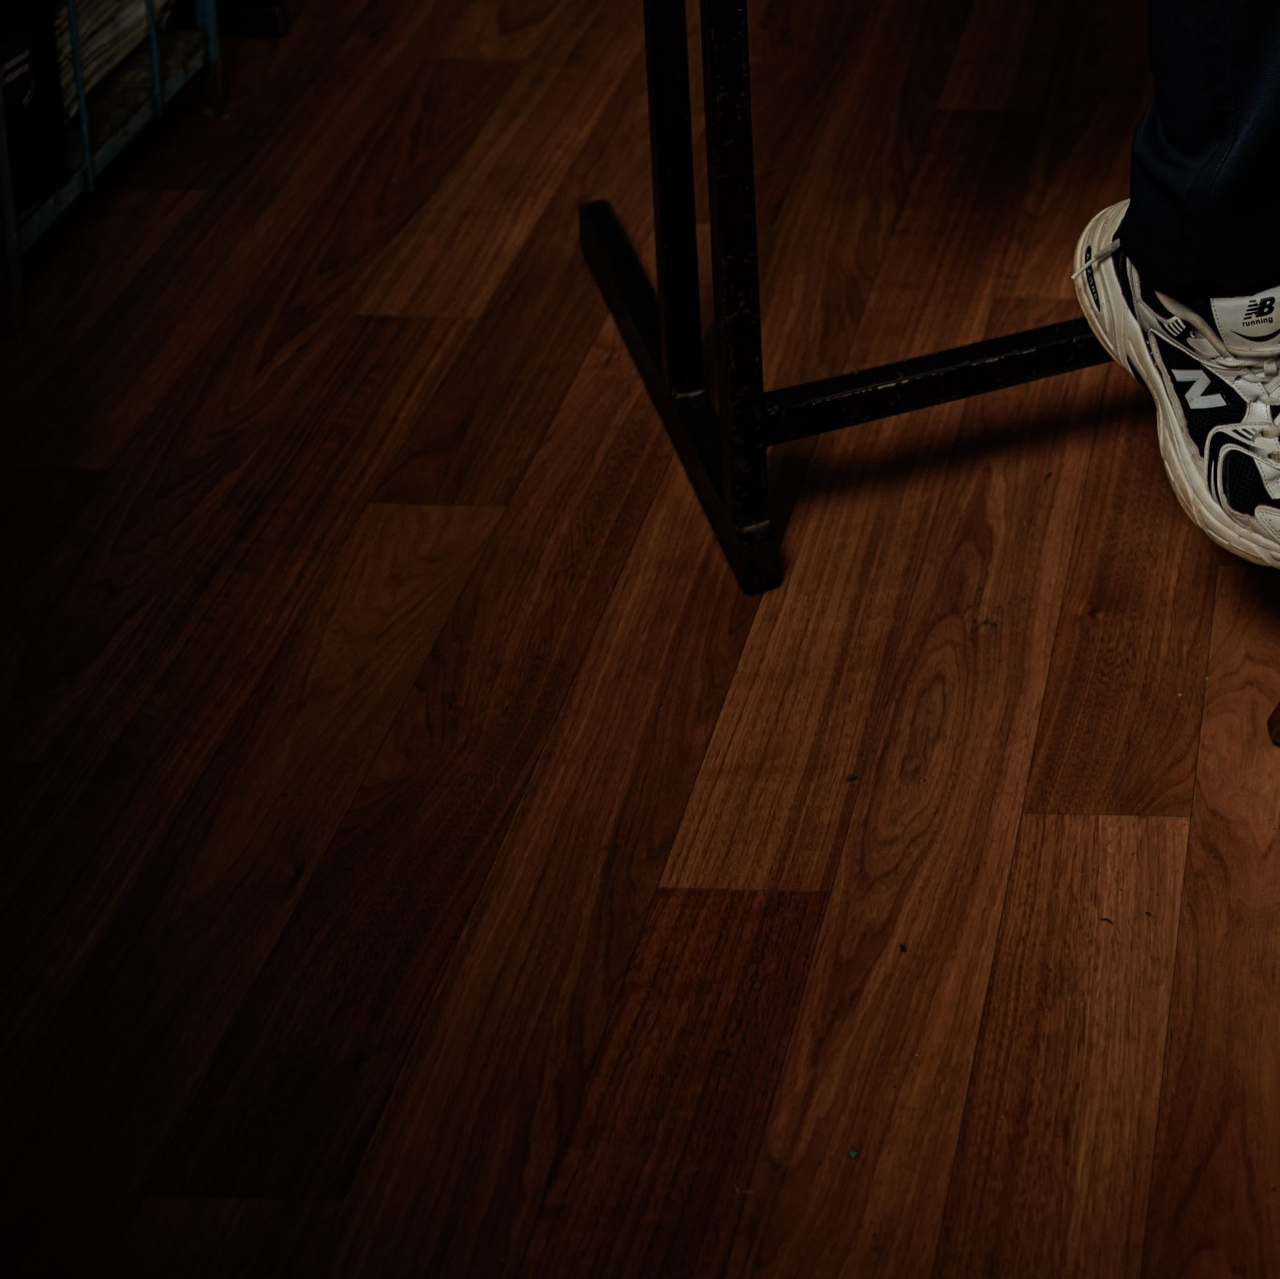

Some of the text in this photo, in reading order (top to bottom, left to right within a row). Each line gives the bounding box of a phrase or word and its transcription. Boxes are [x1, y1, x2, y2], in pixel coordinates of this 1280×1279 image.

[1085, 249, 1100, 306] AZORB
[1241, 314, 1274, 328] running
[1242, 295, 1275, 318] NB
[1173, 368, 1228, 410] N
